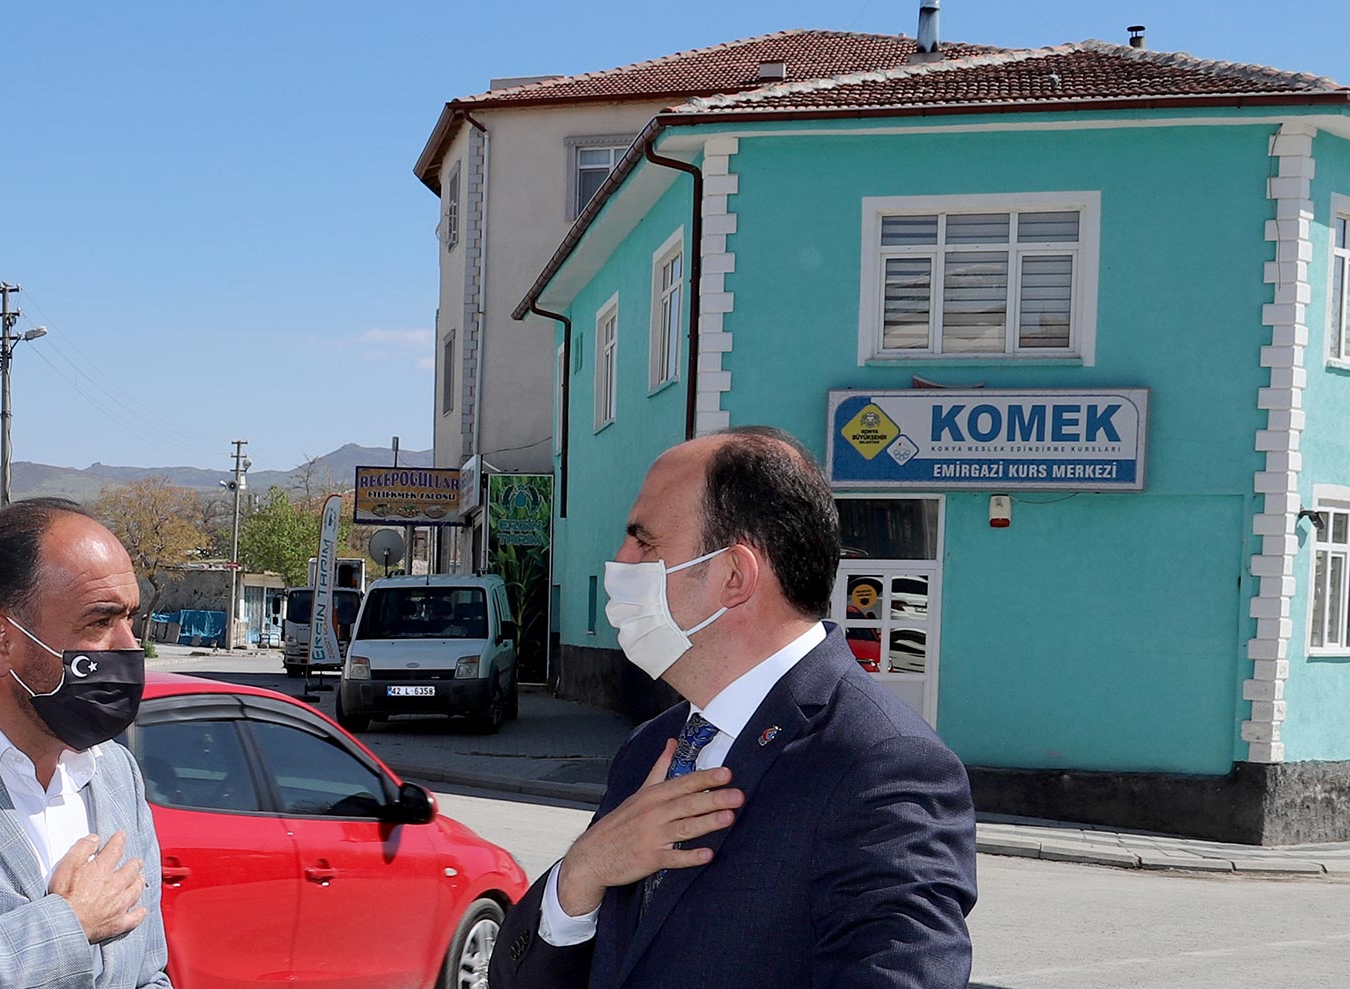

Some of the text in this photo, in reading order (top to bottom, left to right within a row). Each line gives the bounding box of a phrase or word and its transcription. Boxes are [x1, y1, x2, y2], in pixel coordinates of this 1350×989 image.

[931, 404, 1122, 442] KOMEK
[933, 461, 1117, 478] EMİRGAZİ KURS MERKEZİ
